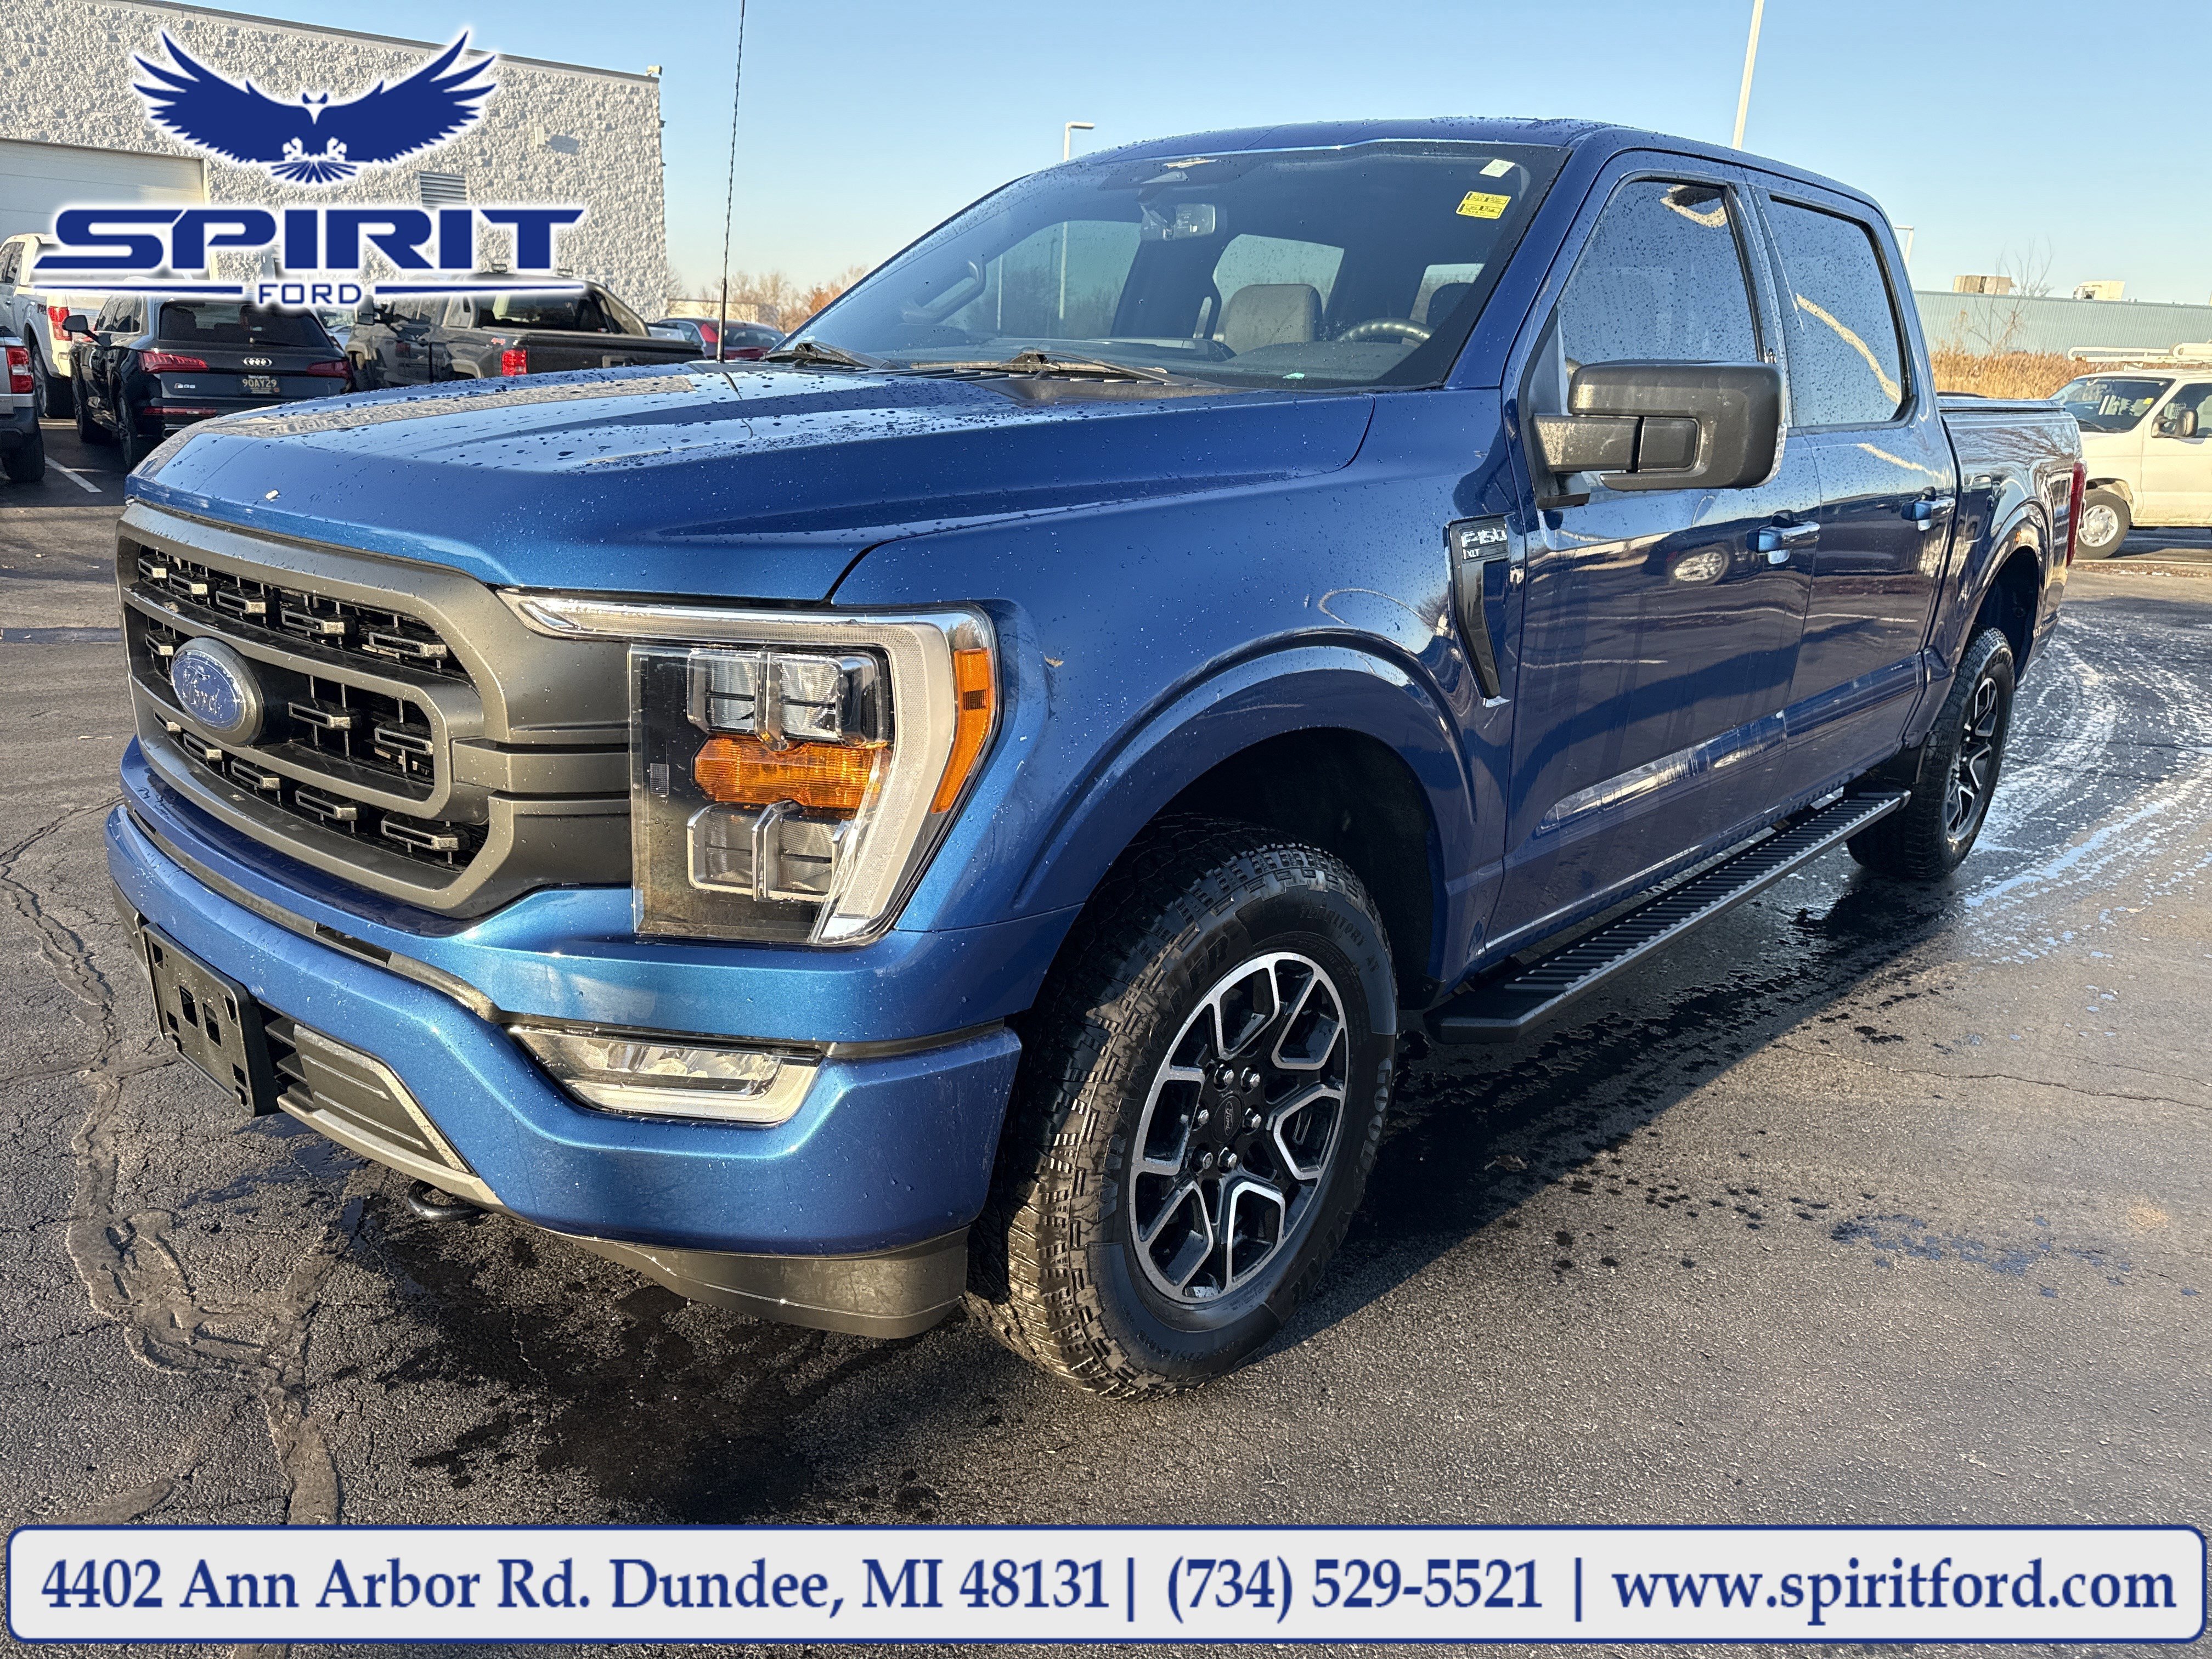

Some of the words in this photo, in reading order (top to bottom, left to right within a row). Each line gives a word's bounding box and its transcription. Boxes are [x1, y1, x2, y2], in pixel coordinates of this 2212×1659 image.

[1460, 528, 1508, 548] F-150
[1466, 549, 1480, 558] XLT
[1300, 905, 1367, 949] TERRITORY
[1096, 933, 1231, 1222] WRANGLER
